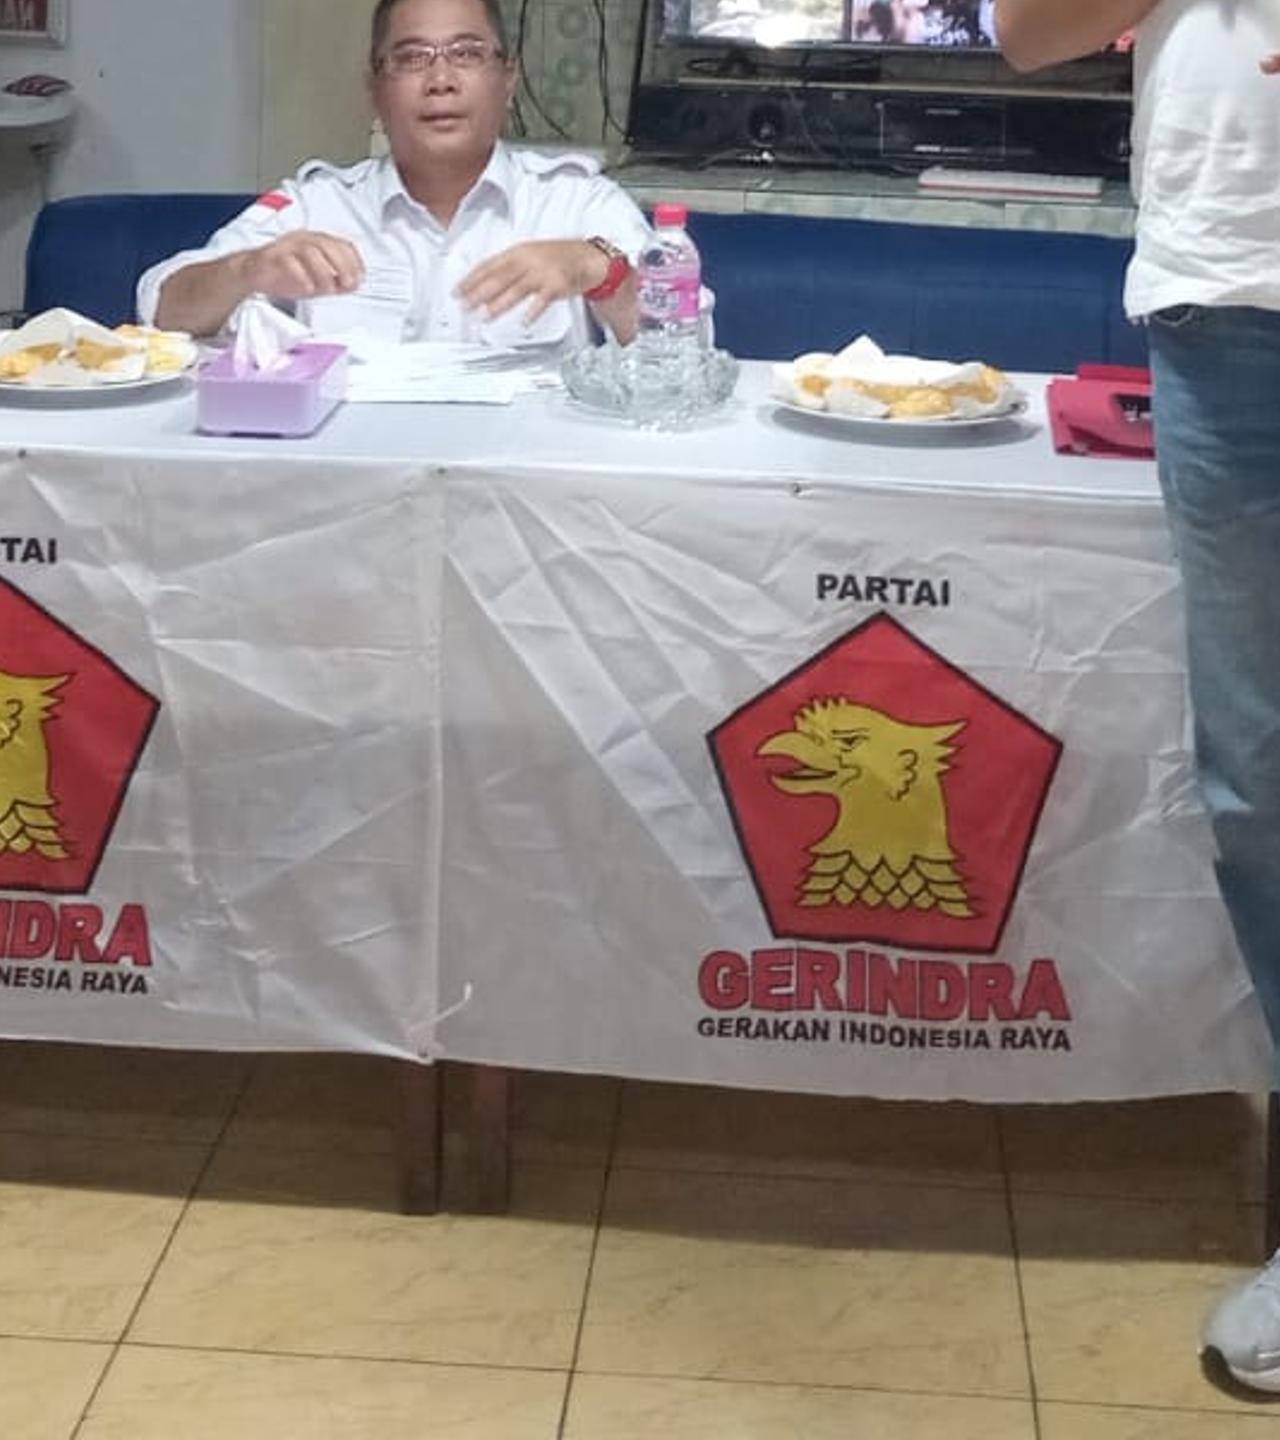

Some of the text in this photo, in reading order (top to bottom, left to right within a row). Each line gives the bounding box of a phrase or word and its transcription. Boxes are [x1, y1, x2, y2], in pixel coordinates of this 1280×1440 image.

[817, 574, 951, 607] PARTAI
[81, 970, 148, 995] RAYA
[697, 949, 1072, 1021] GERINDRA
[697, 1016, 1072, 1052] GERAKAN INDONESIA RAYA
